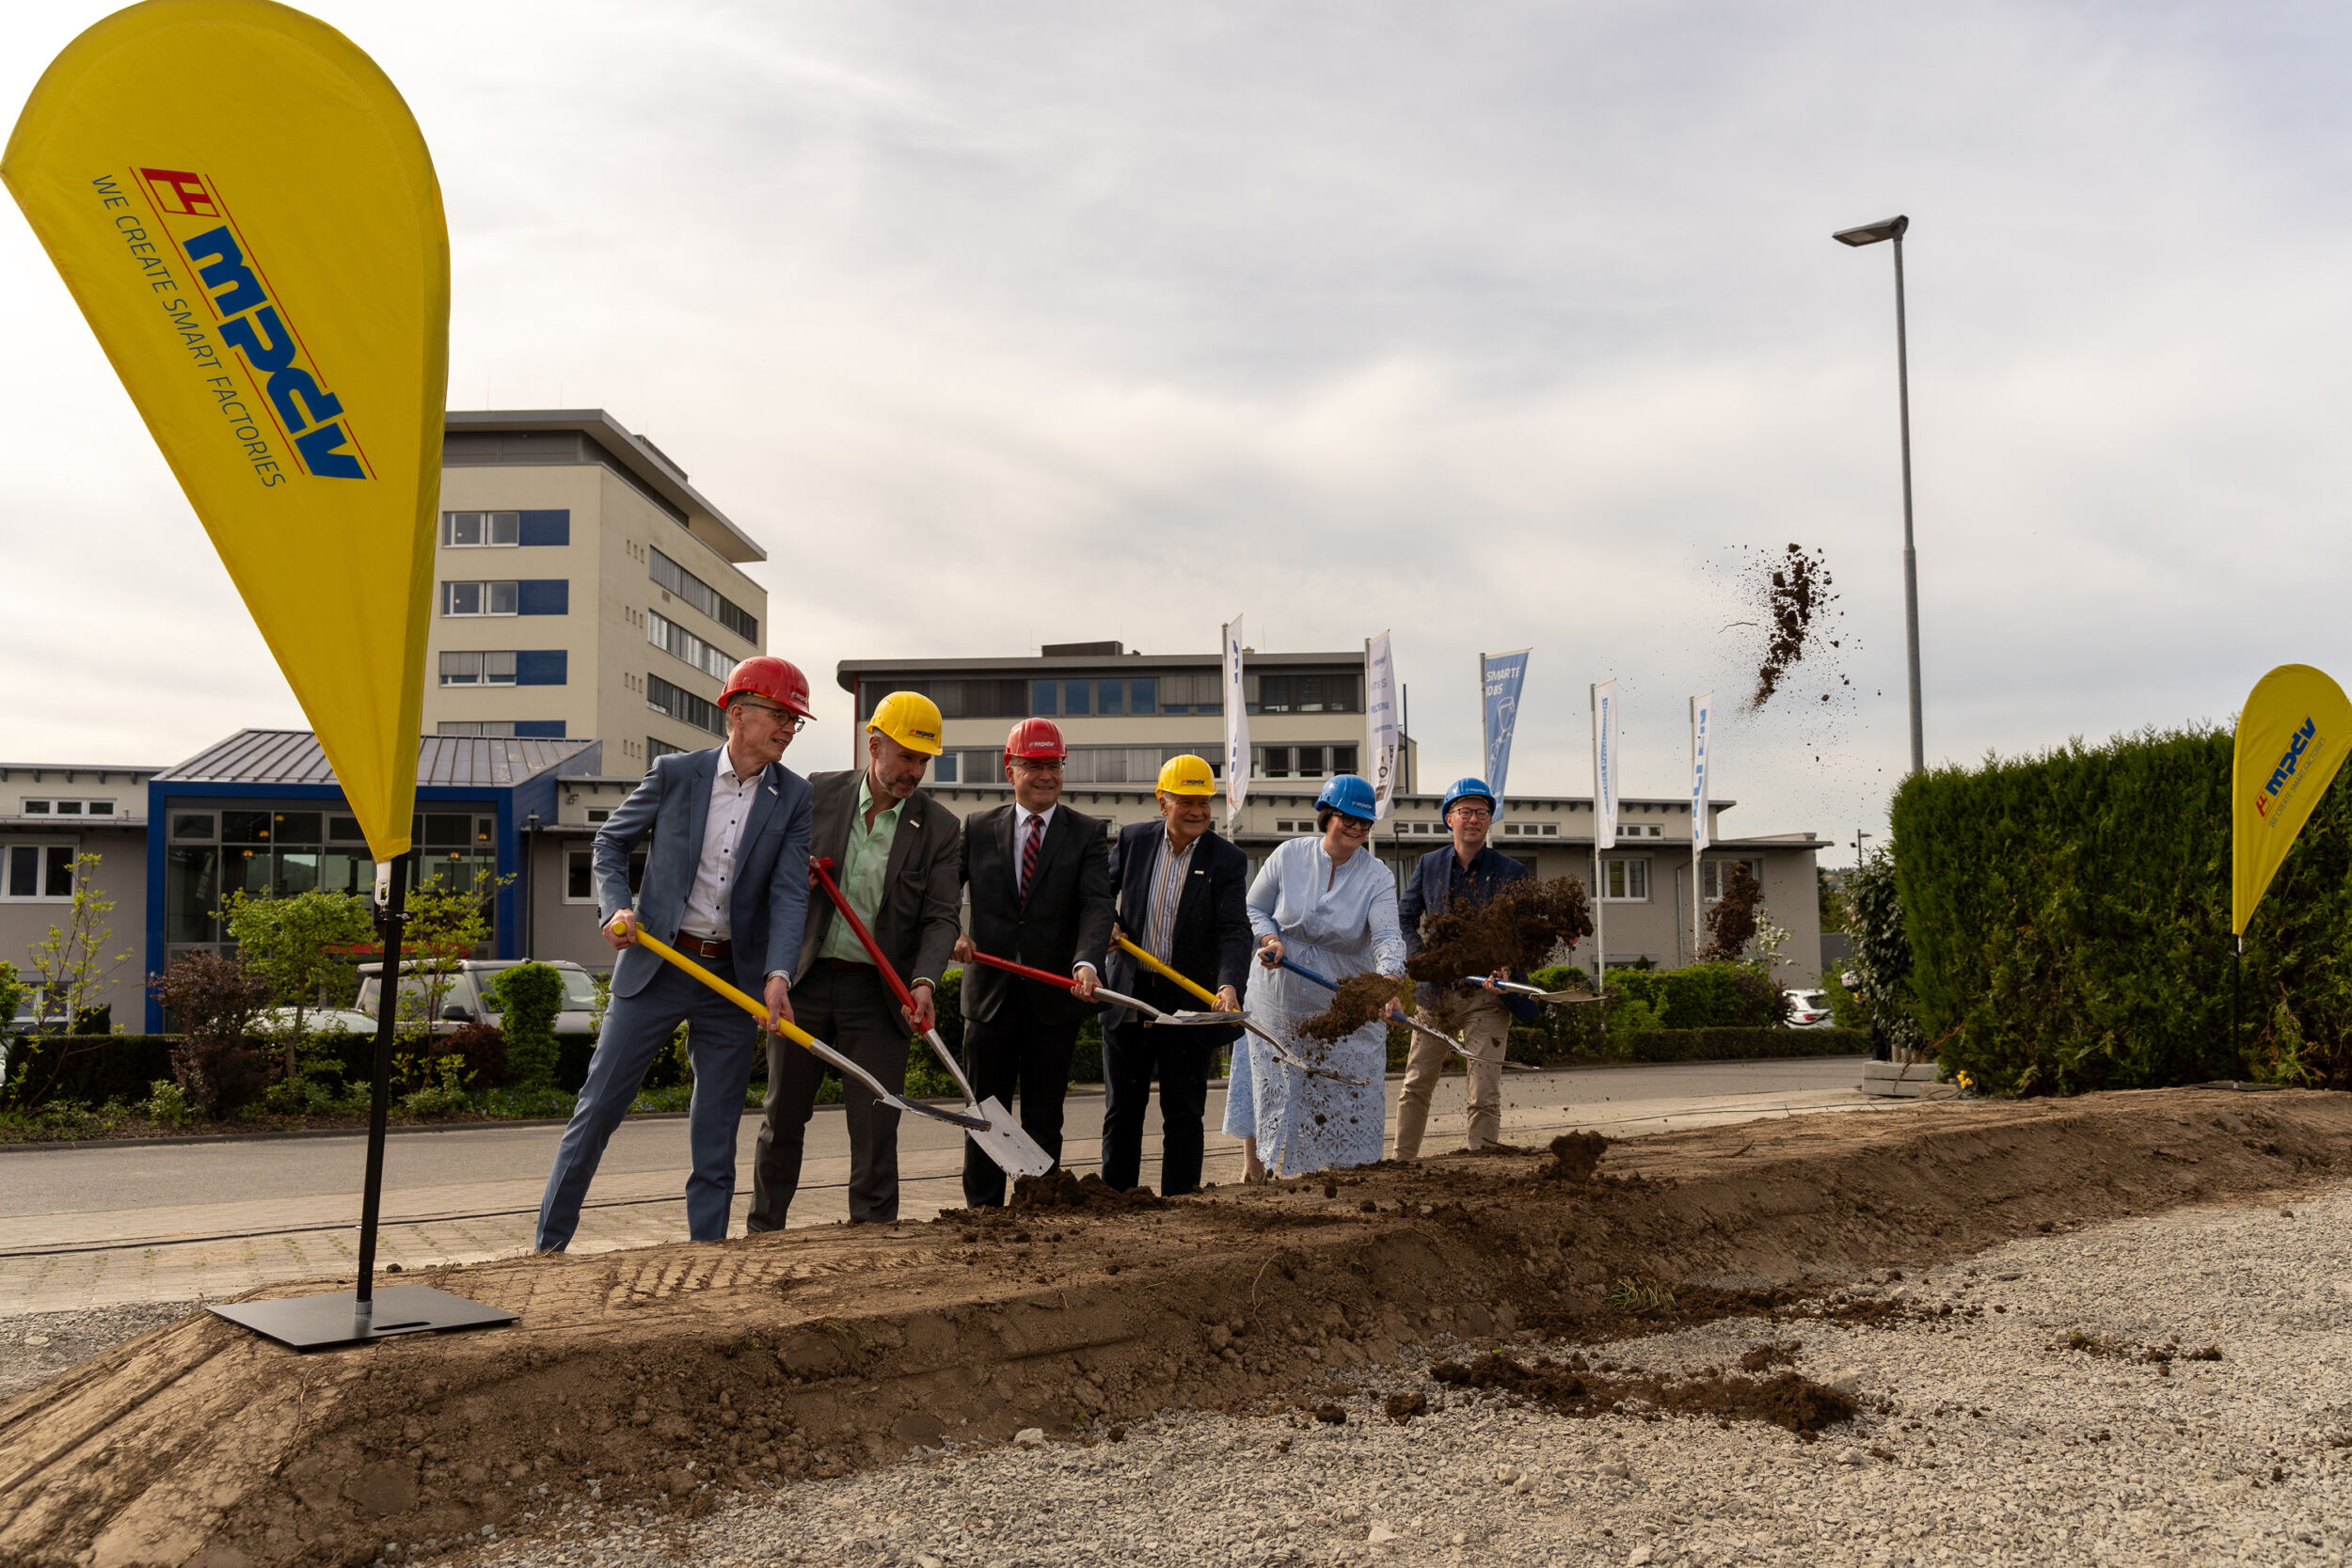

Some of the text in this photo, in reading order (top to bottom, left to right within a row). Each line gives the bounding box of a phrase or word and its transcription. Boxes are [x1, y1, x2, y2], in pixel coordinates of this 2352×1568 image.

[91, 174, 286, 488] WE CREATE SMART FACTORIES
[182, 225, 368, 481] mpdv
[1486, 683, 1503, 698] OBS
[2265, 716, 2316, 797] mpdv
